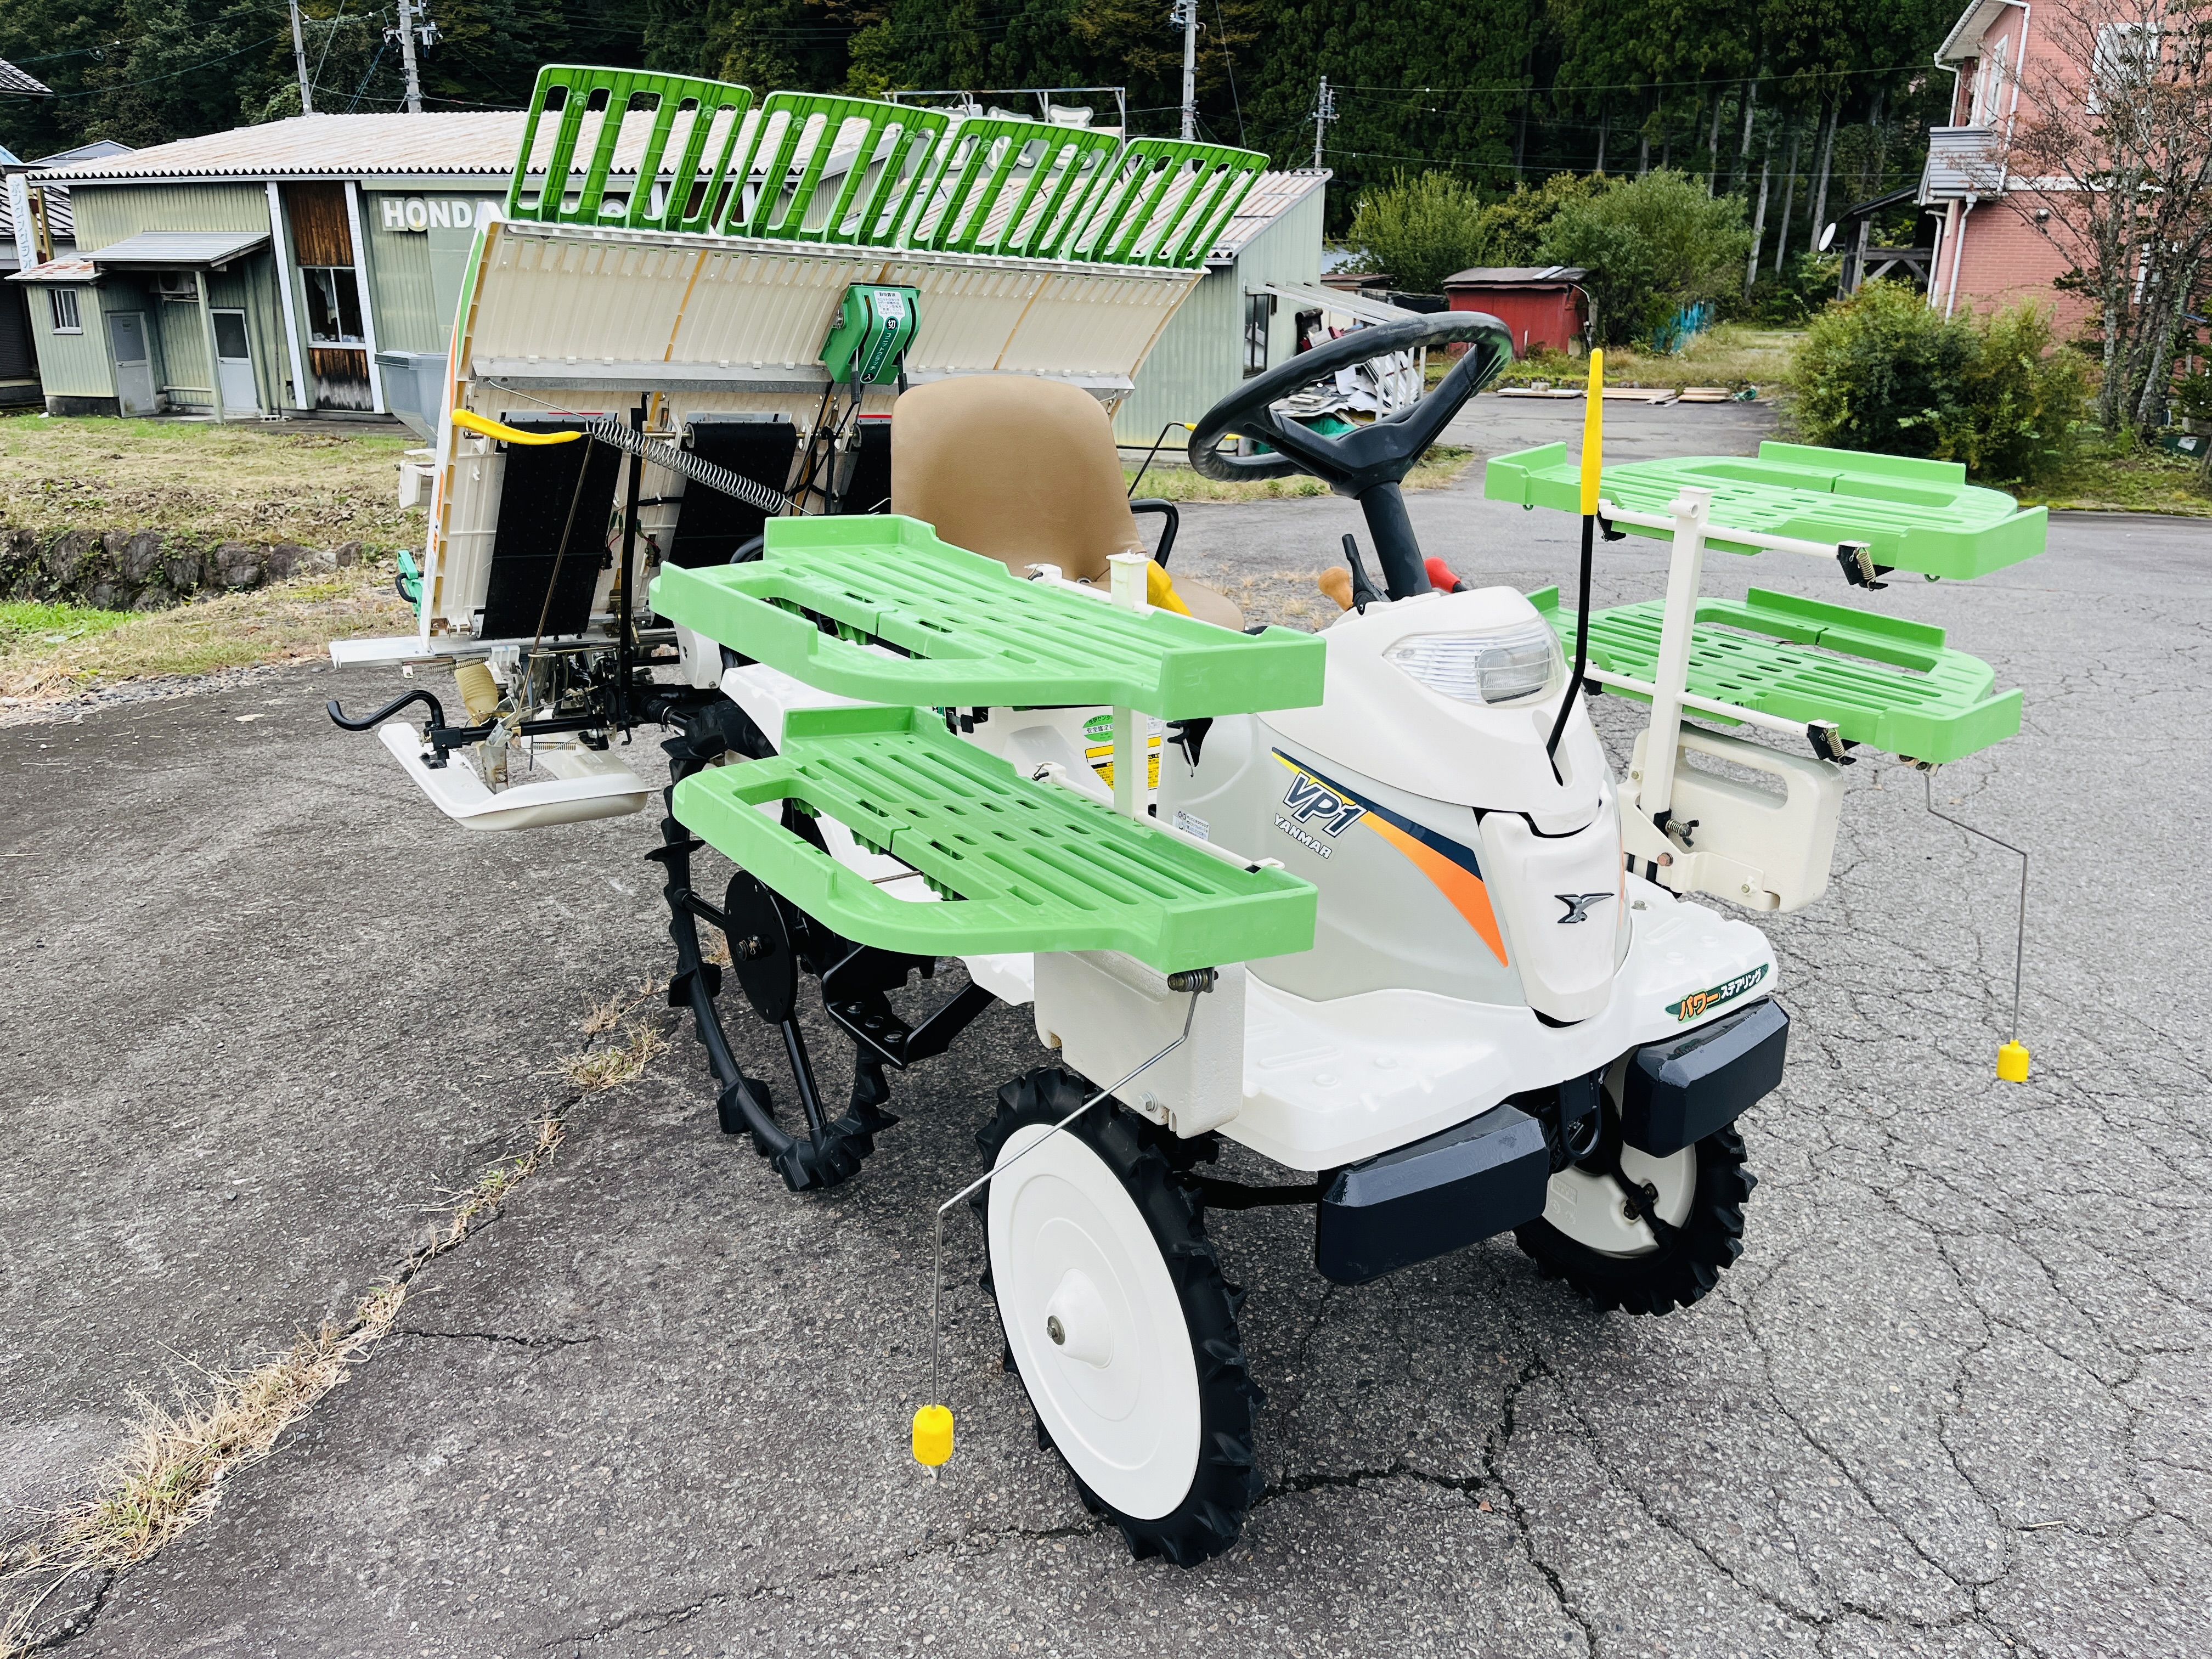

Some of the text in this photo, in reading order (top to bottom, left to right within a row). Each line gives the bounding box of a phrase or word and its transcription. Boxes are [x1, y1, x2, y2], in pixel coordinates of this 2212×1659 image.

[888, 319, 896, 329] 切
[870, 332, 892, 371] ユニットクラッチ
[1283, 771, 1369, 838] VP1
[1274, 813, 1333, 859] YANMAR
